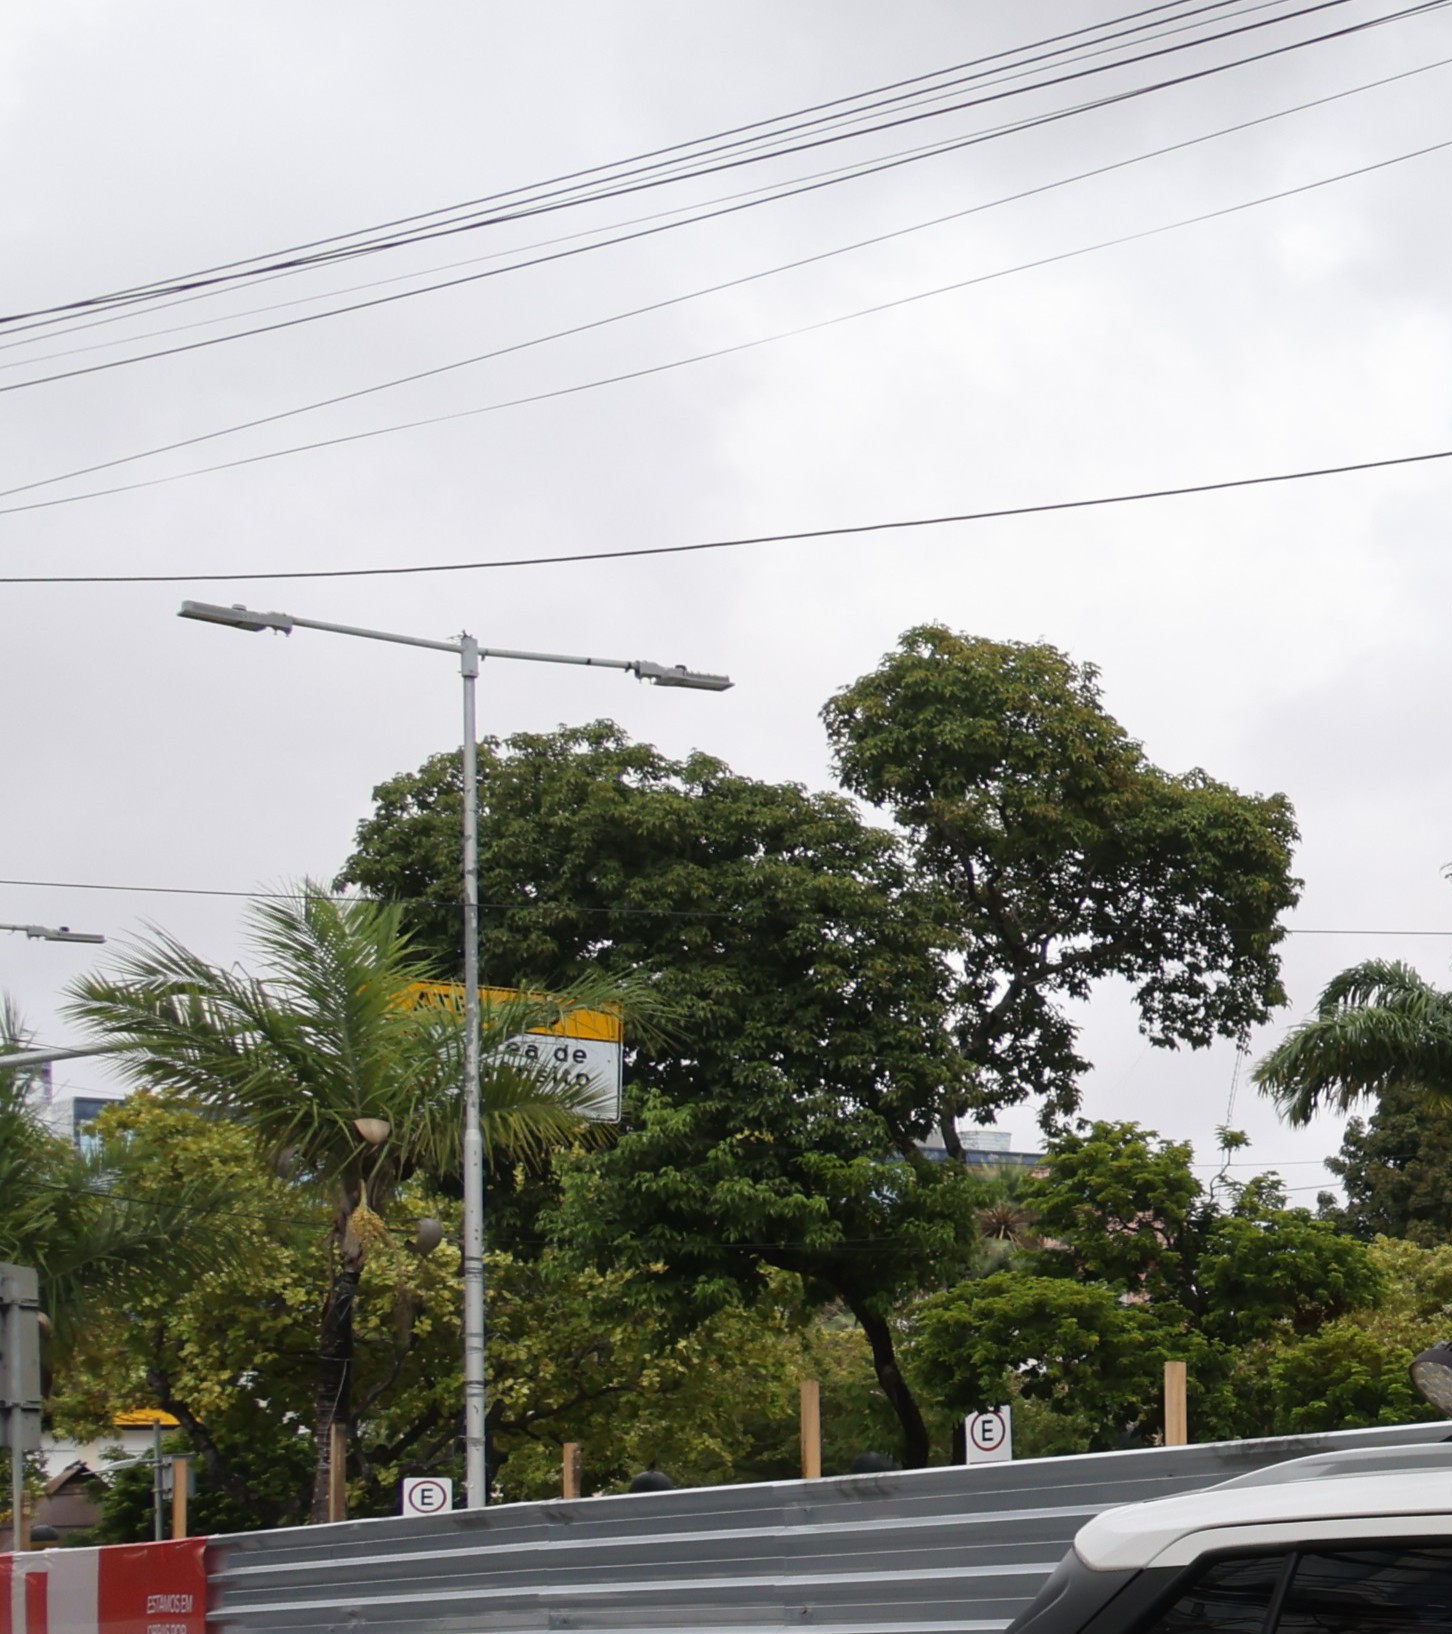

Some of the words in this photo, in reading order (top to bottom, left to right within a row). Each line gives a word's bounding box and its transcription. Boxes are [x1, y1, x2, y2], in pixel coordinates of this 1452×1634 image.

[554, 1044, 588, 1064] de
[981, 1420, 994, 1442] E
[421, 1488, 434, 1506] E
[147, 1594, 180, 1614] ESTAMOS
